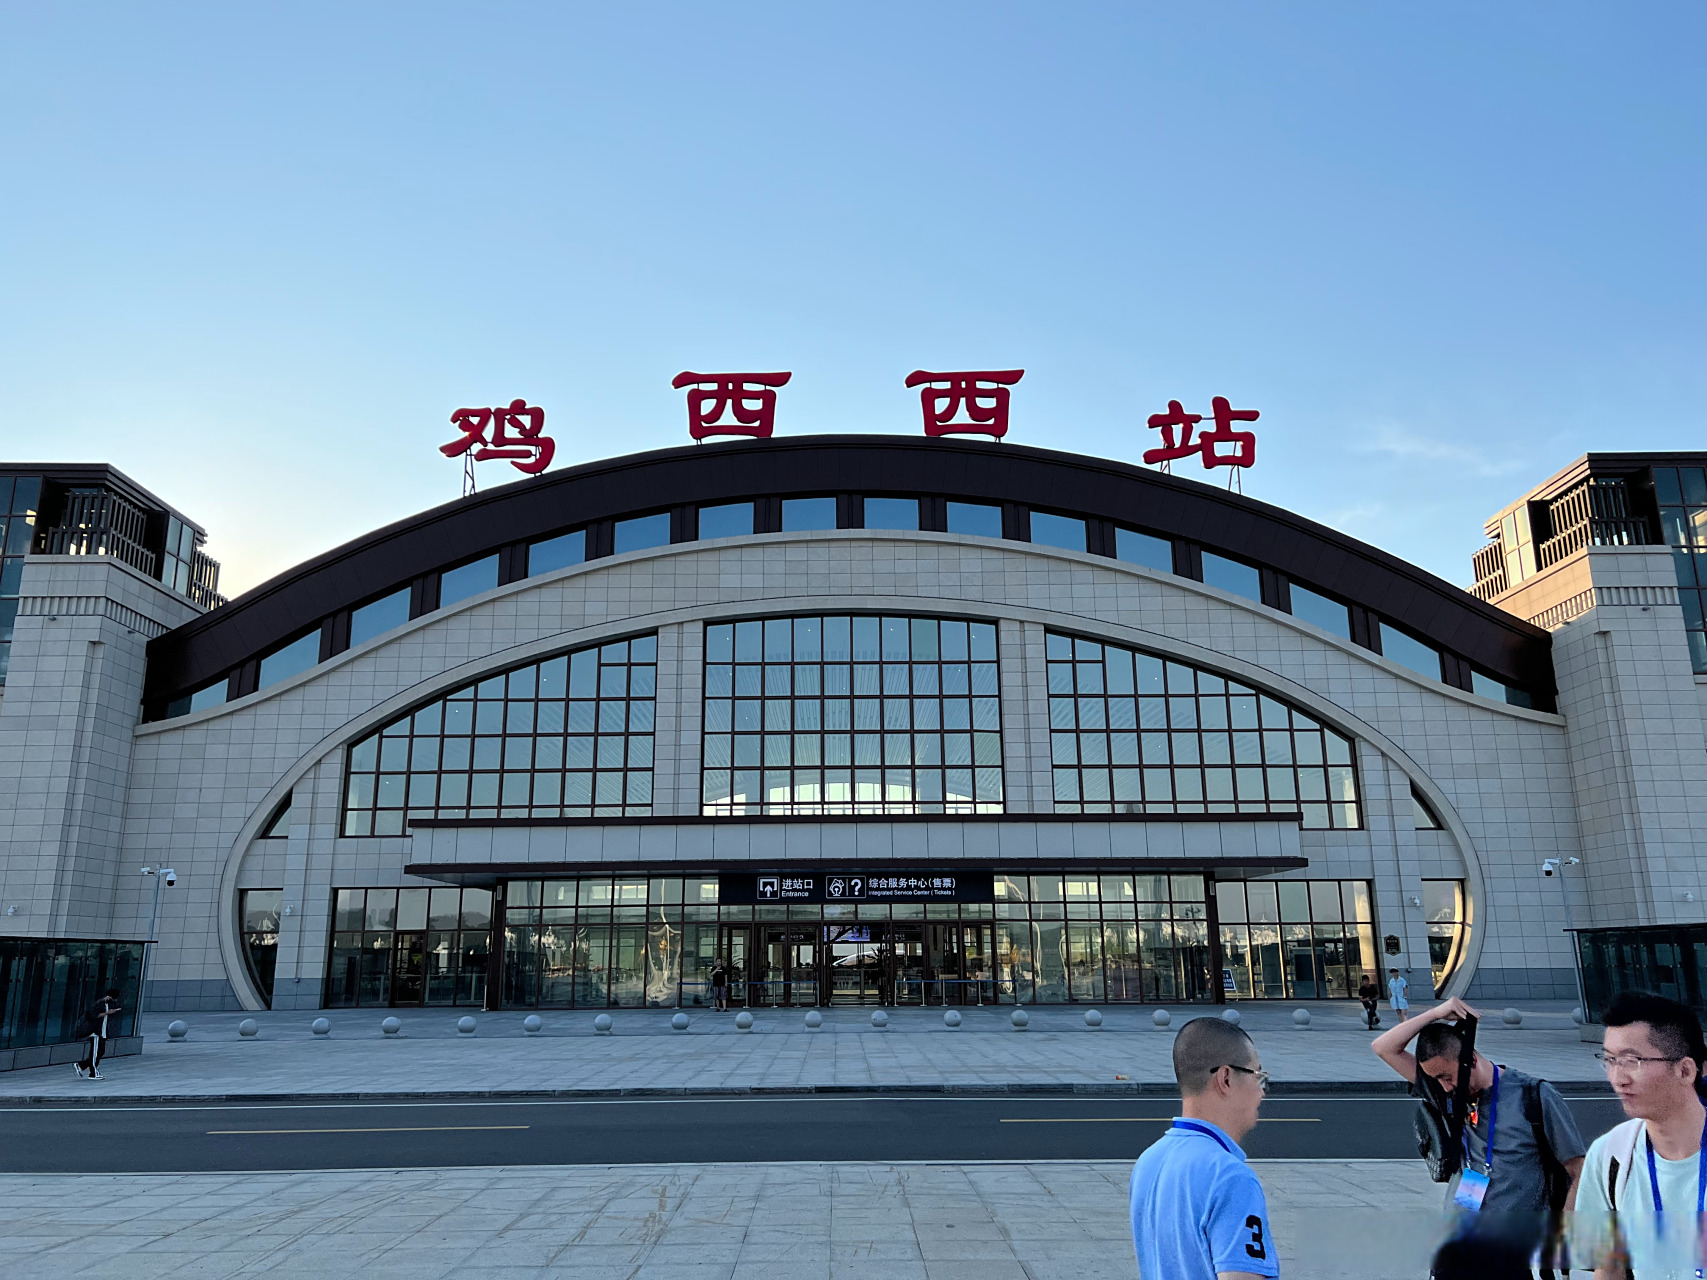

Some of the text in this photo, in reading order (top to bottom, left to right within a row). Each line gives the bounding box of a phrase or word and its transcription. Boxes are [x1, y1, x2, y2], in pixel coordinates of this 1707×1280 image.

[439, 369, 1260, 475] 鸡西西站
[781, 879, 813, 890] 进站口
[1245, 1214, 1266, 1260] 3
